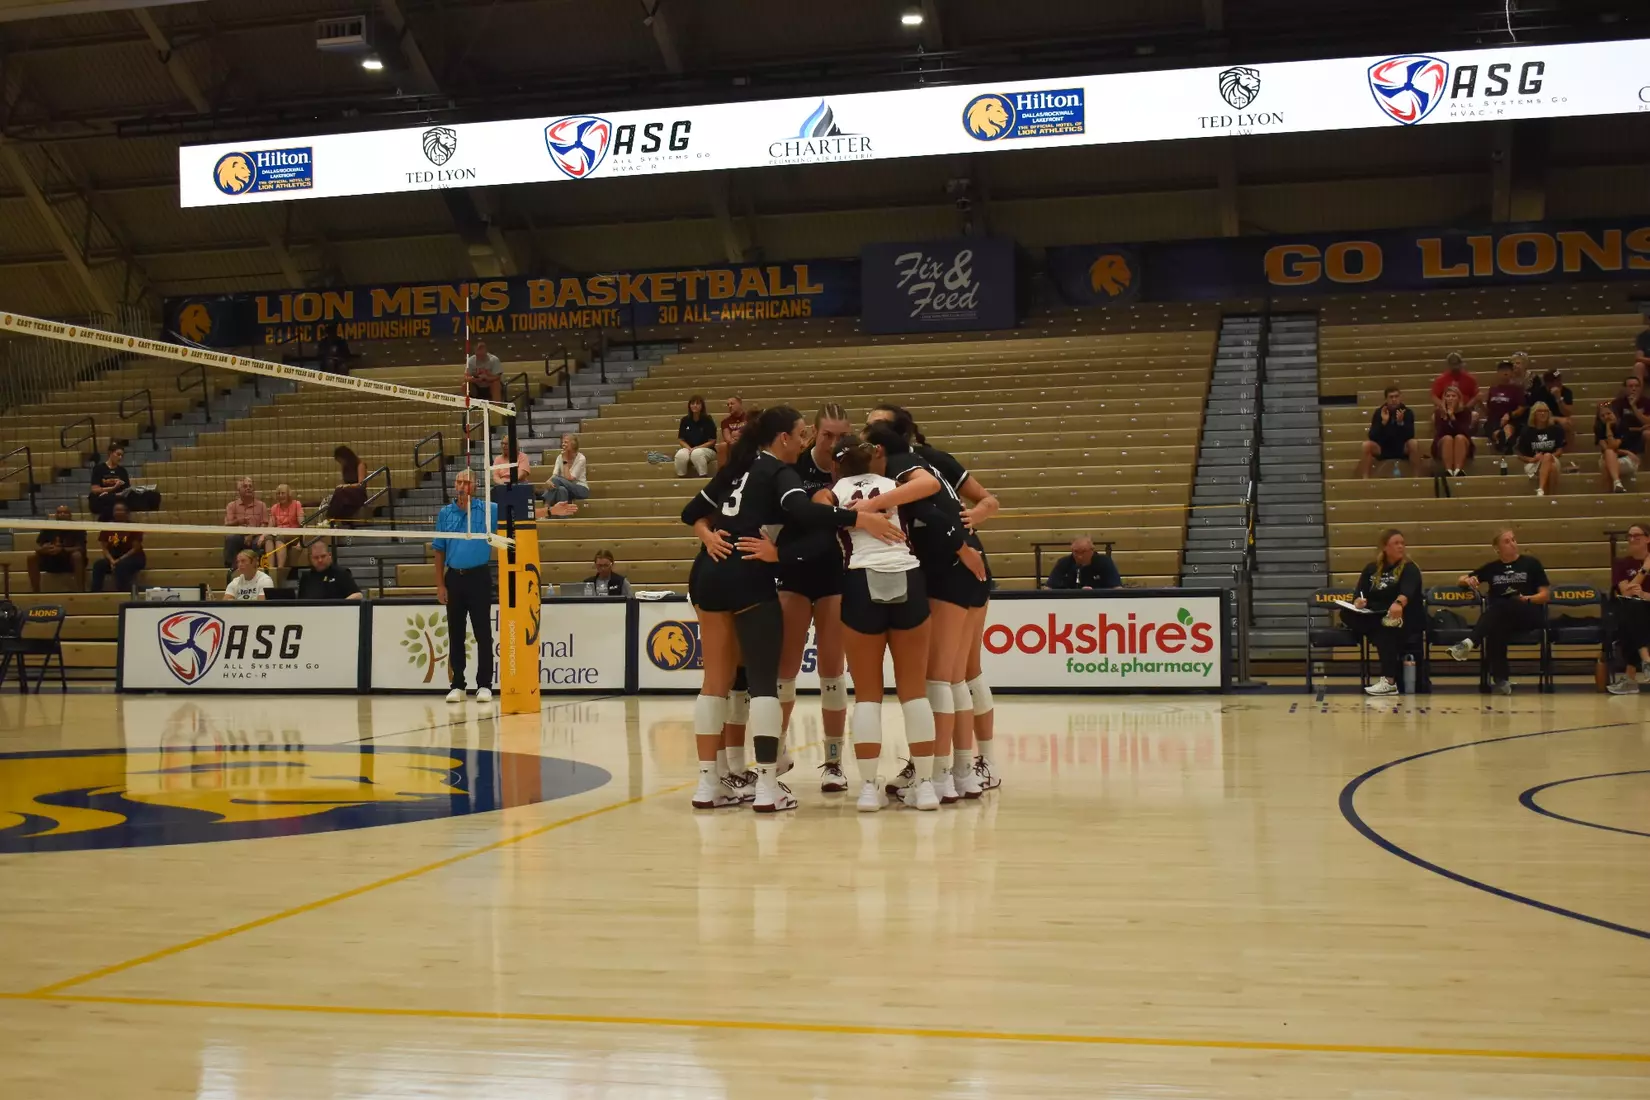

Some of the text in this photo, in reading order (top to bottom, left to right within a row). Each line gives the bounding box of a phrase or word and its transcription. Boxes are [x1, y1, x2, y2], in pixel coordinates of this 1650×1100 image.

[1450, 60, 1545, 99] ASG
[1016, 93, 1080, 110] Hilton
[1039, 125, 1083, 134] ATHLETICS
[1198, 111, 1284, 129] TED LYON
[613, 120, 692, 155] ASG
[768, 137, 873, 158] CHARTER
[257, 152, 309, 167] Hilton
[405, 168, 476, 184] TED LYON
[1263, 226, 1650, 286] GO LIONS
[894, 249, 973, 291] Fix &
[255, 264, 824, 324] LION MEN'S BASKETBALL
[907, 281, 980, 318] Feed
[659, 298, 812, 325] 30 ALL-AMERICANS
[16, 318, 32, 328] EAST
[33, 322, 52, 332] TEXAS
[316, 318, 432, 342] CAMPIONSHIPS
[452, 316, 461, 335] 7
[466, 314, 505, 334] NCAA
[721, 471, 749, 516] 3
[1316, 593, 1354, 603] LIONS
[1433, 591, 1475, 600] LIONS
[1554, 590, 1595, 599] LIONS
[28, 609, 58, 617] LIONS
[224, 624, 303, 659] ASG
